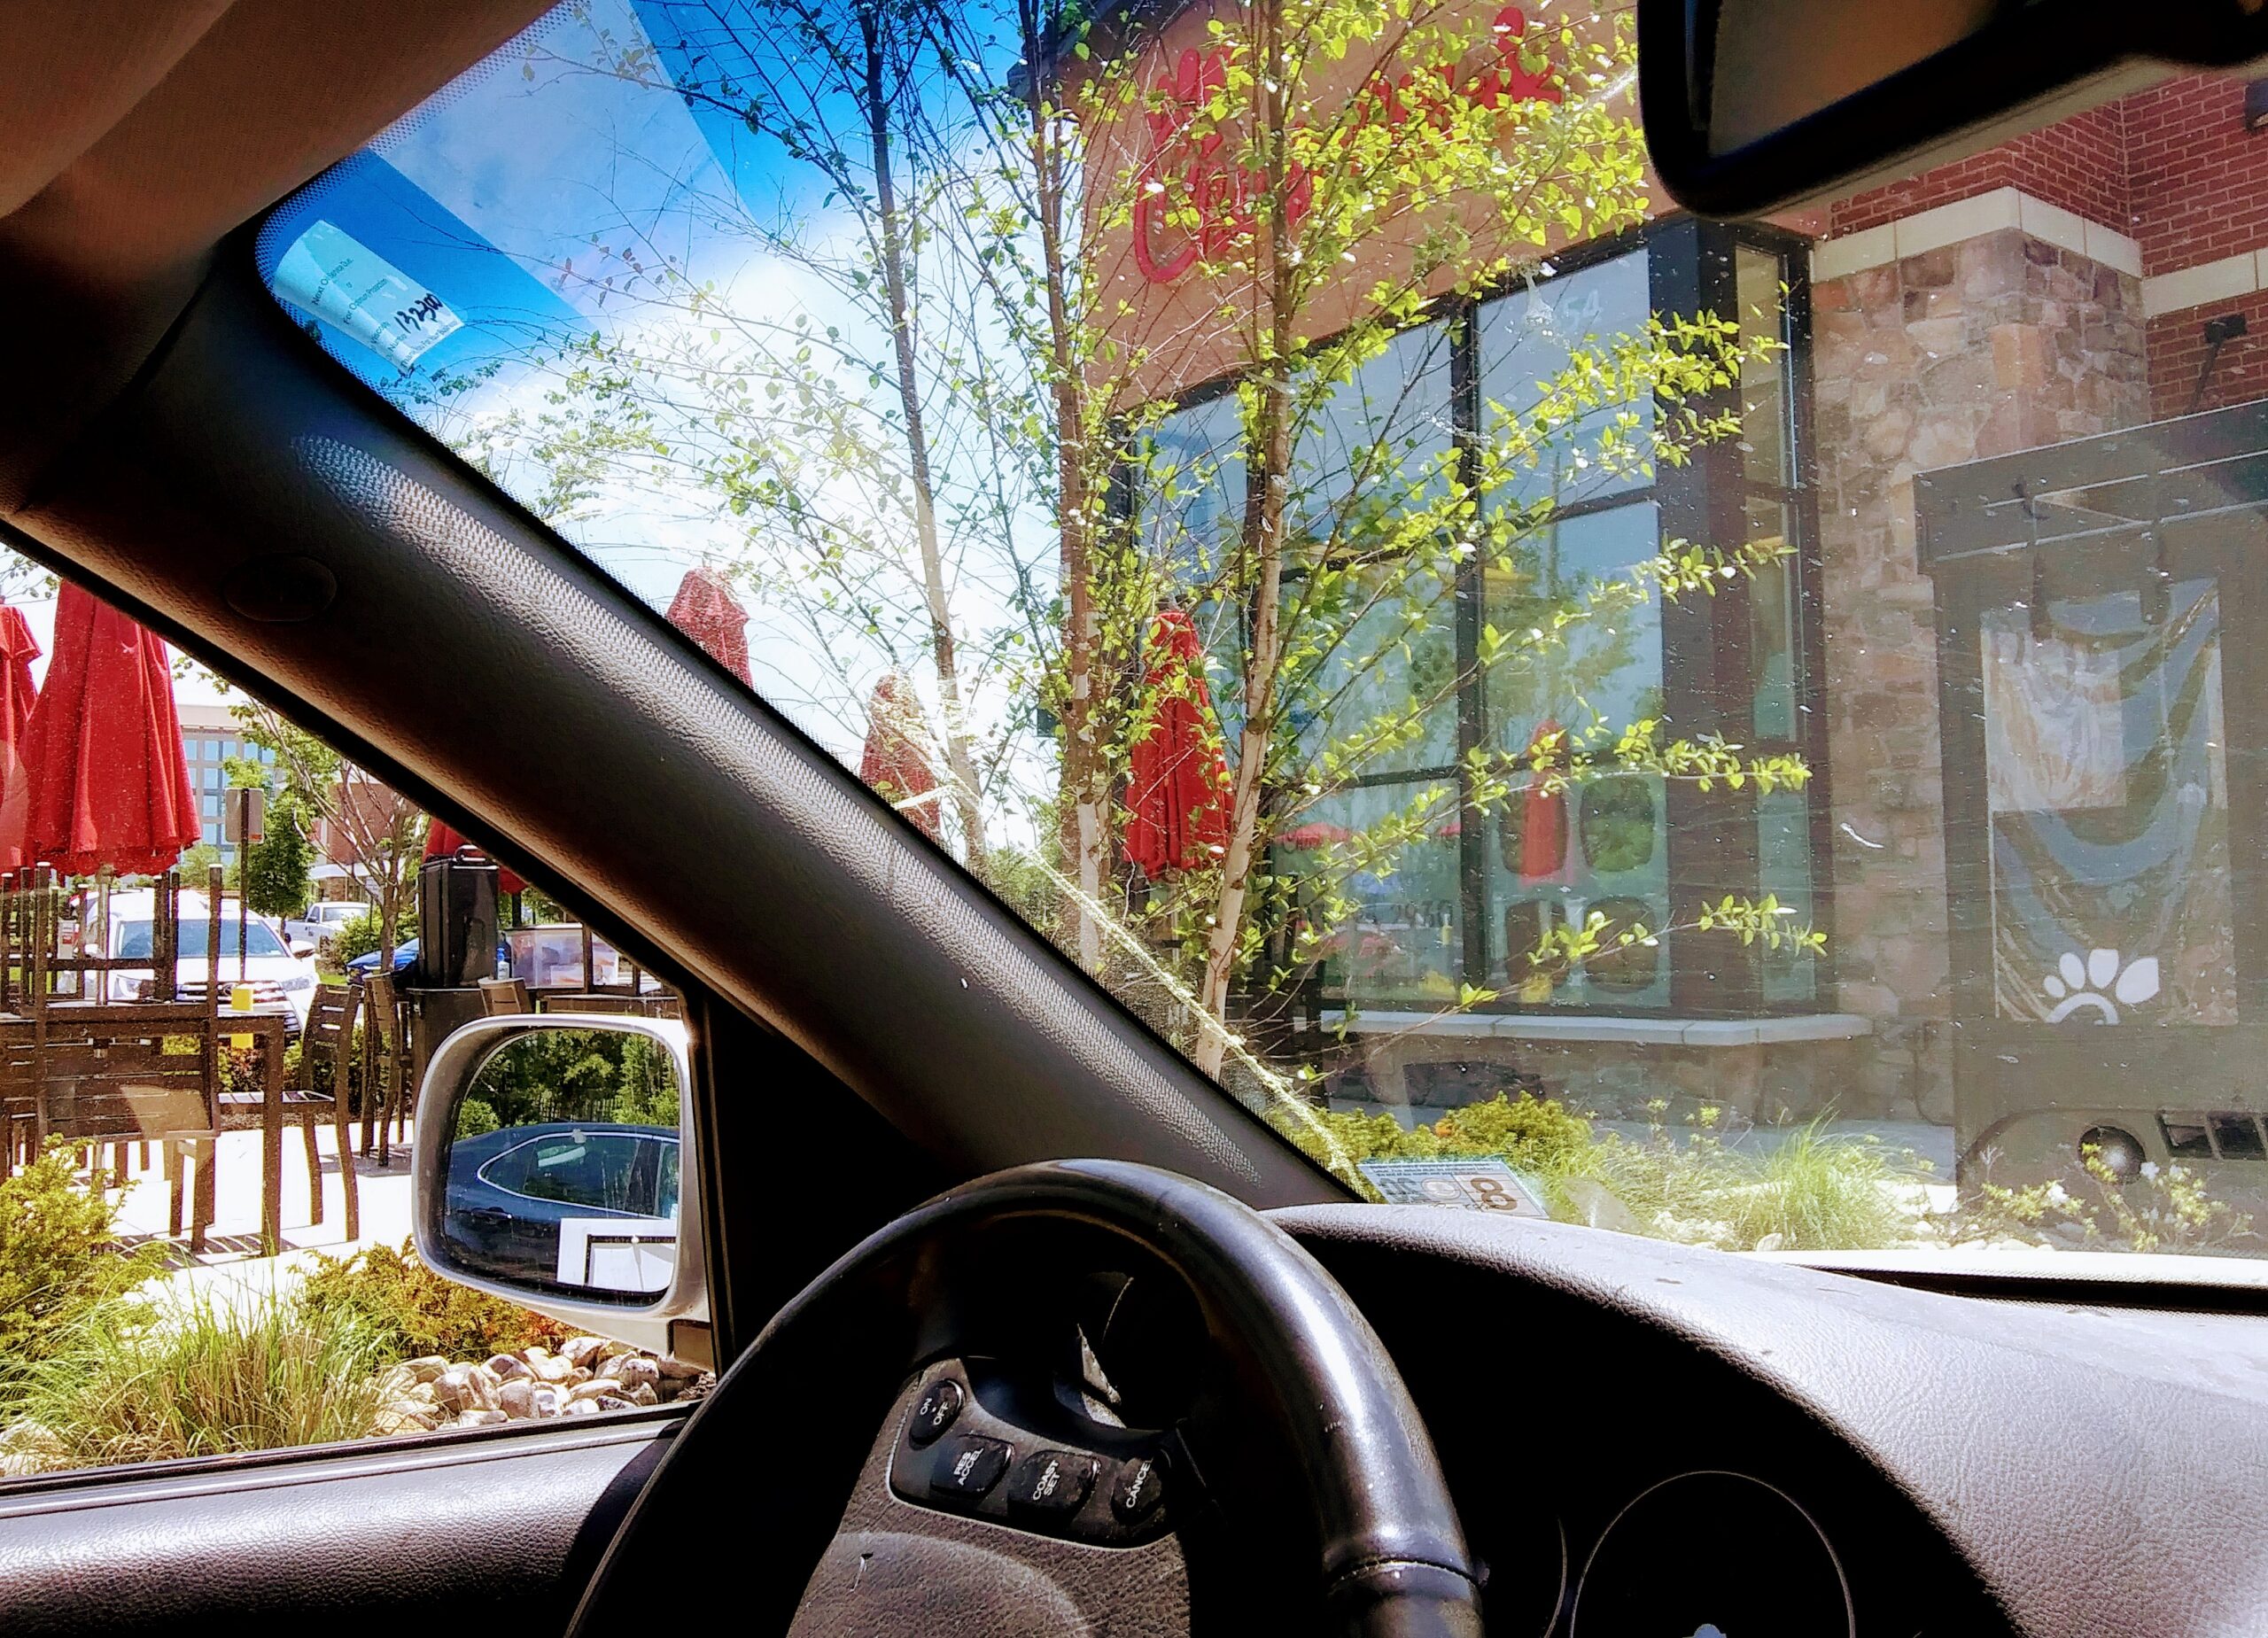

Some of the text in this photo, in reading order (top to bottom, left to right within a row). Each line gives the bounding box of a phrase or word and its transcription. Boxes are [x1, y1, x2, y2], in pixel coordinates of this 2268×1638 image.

[311, 286, 324, 305] Next
[342, 309, 353, 324] For
[1470, 1177, 1518, 1210] 8
[920, 1397, 933, 1416] ON
[933, 1401, 950, 1425] OFF
[953, 1451, 969, 1475] RES
[958, 1447, 984, 1486] ACCEL
[1032, 1459, 1059, 1502] COAST
[1044, 1472, 1061, 1496] SET
[1125, 1458, 1153, 1509] CANCEL
